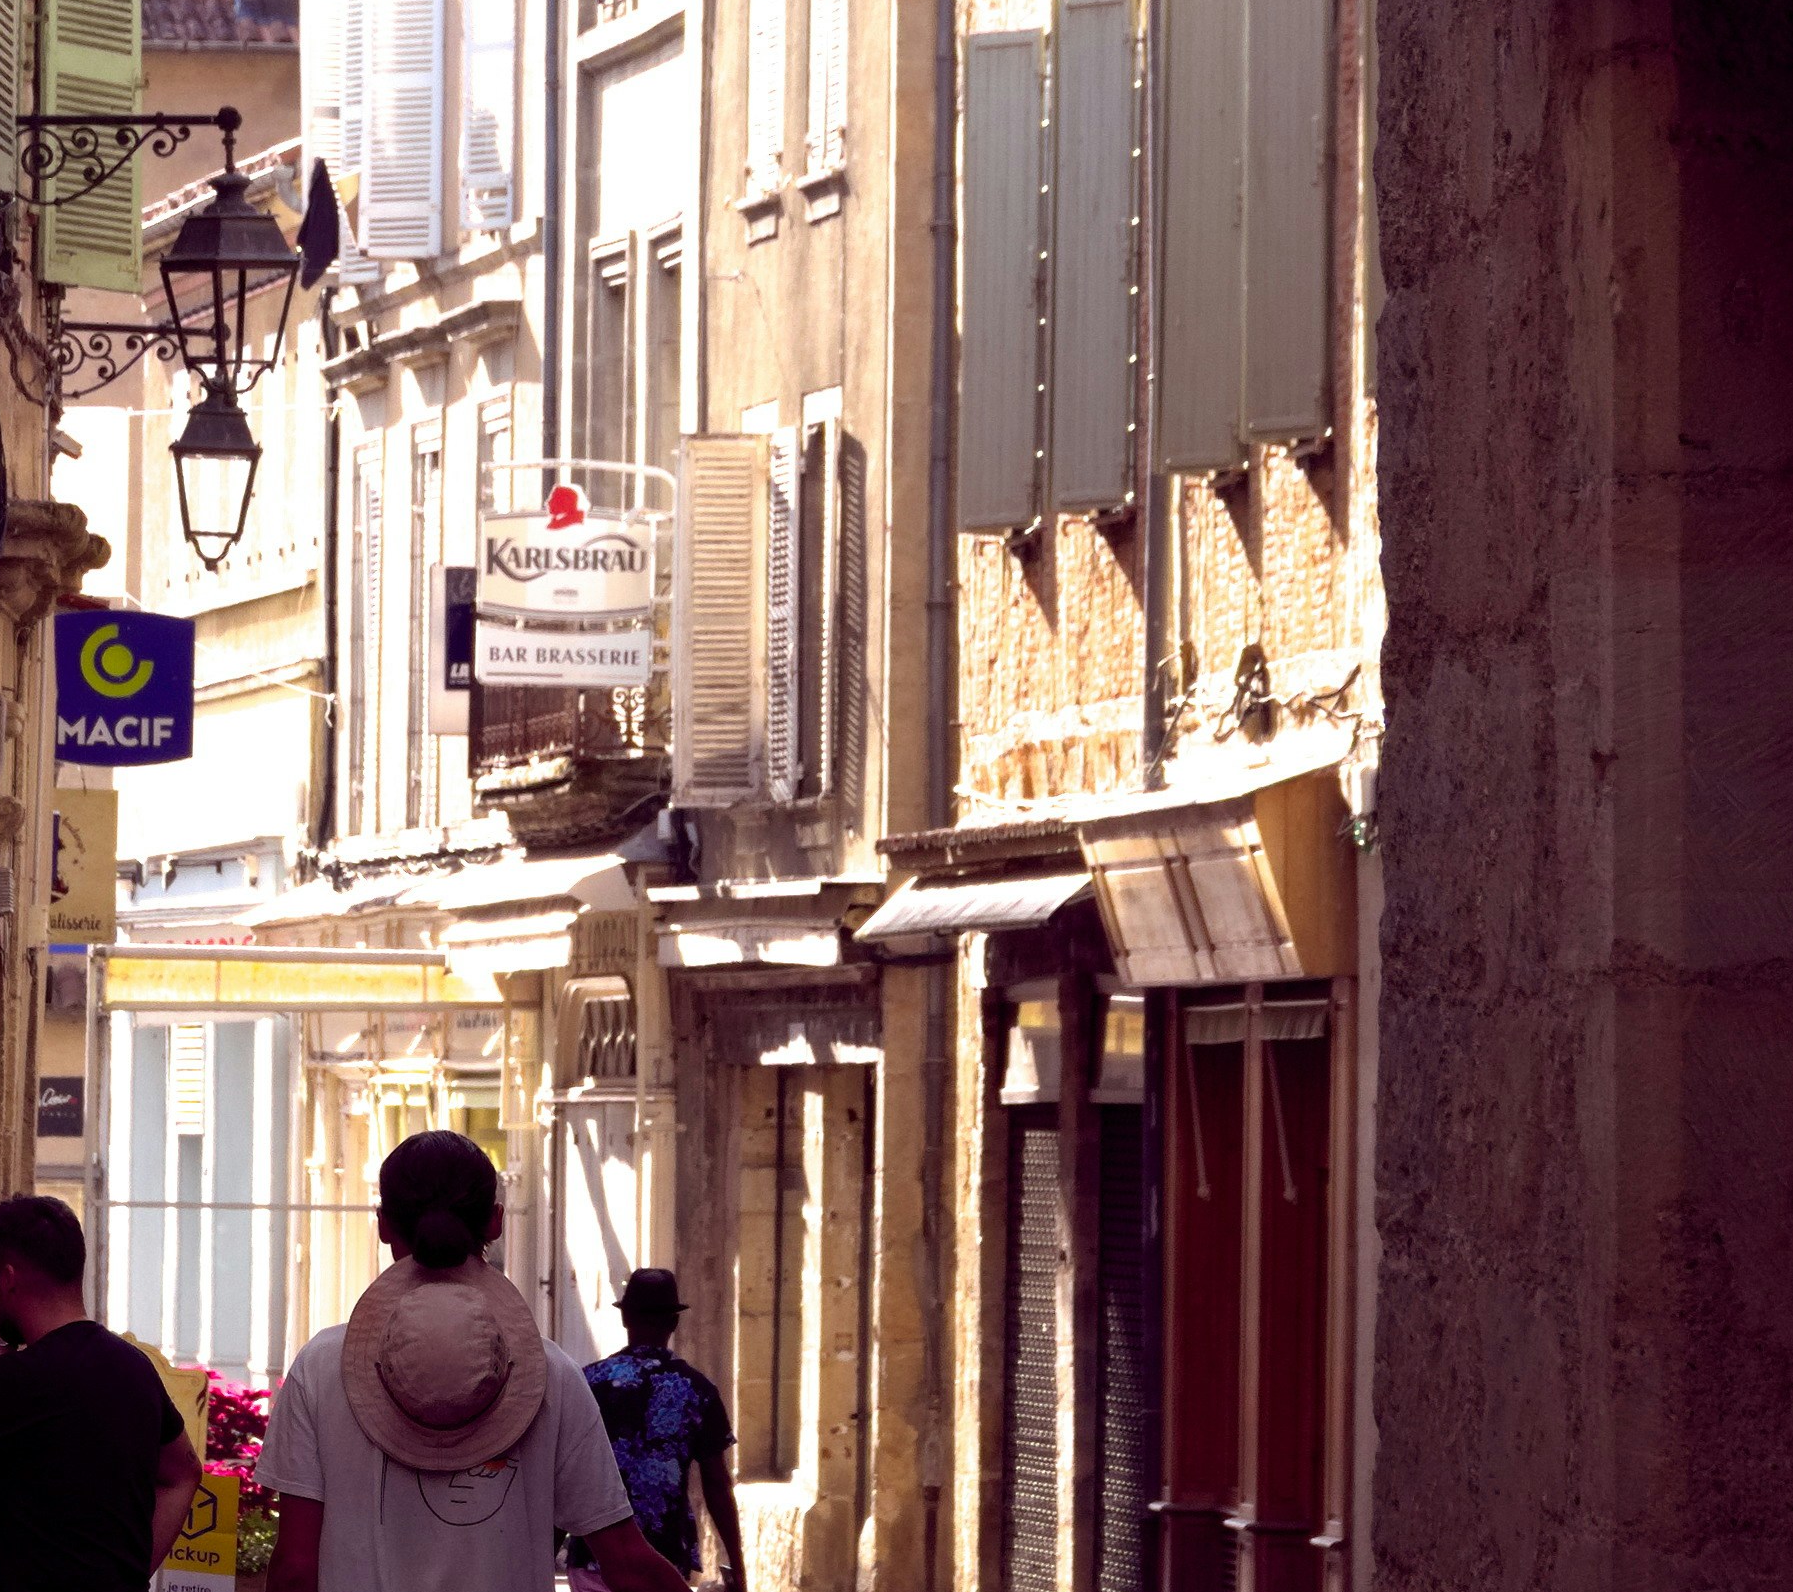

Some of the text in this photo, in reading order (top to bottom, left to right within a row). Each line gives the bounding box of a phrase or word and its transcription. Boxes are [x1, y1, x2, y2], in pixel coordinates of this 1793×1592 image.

[489, 645, 641, 667] BAR BRASSERIE
[57, 715, 175, 748] MACIF
[168, 1545, 221, 1567] ickup
